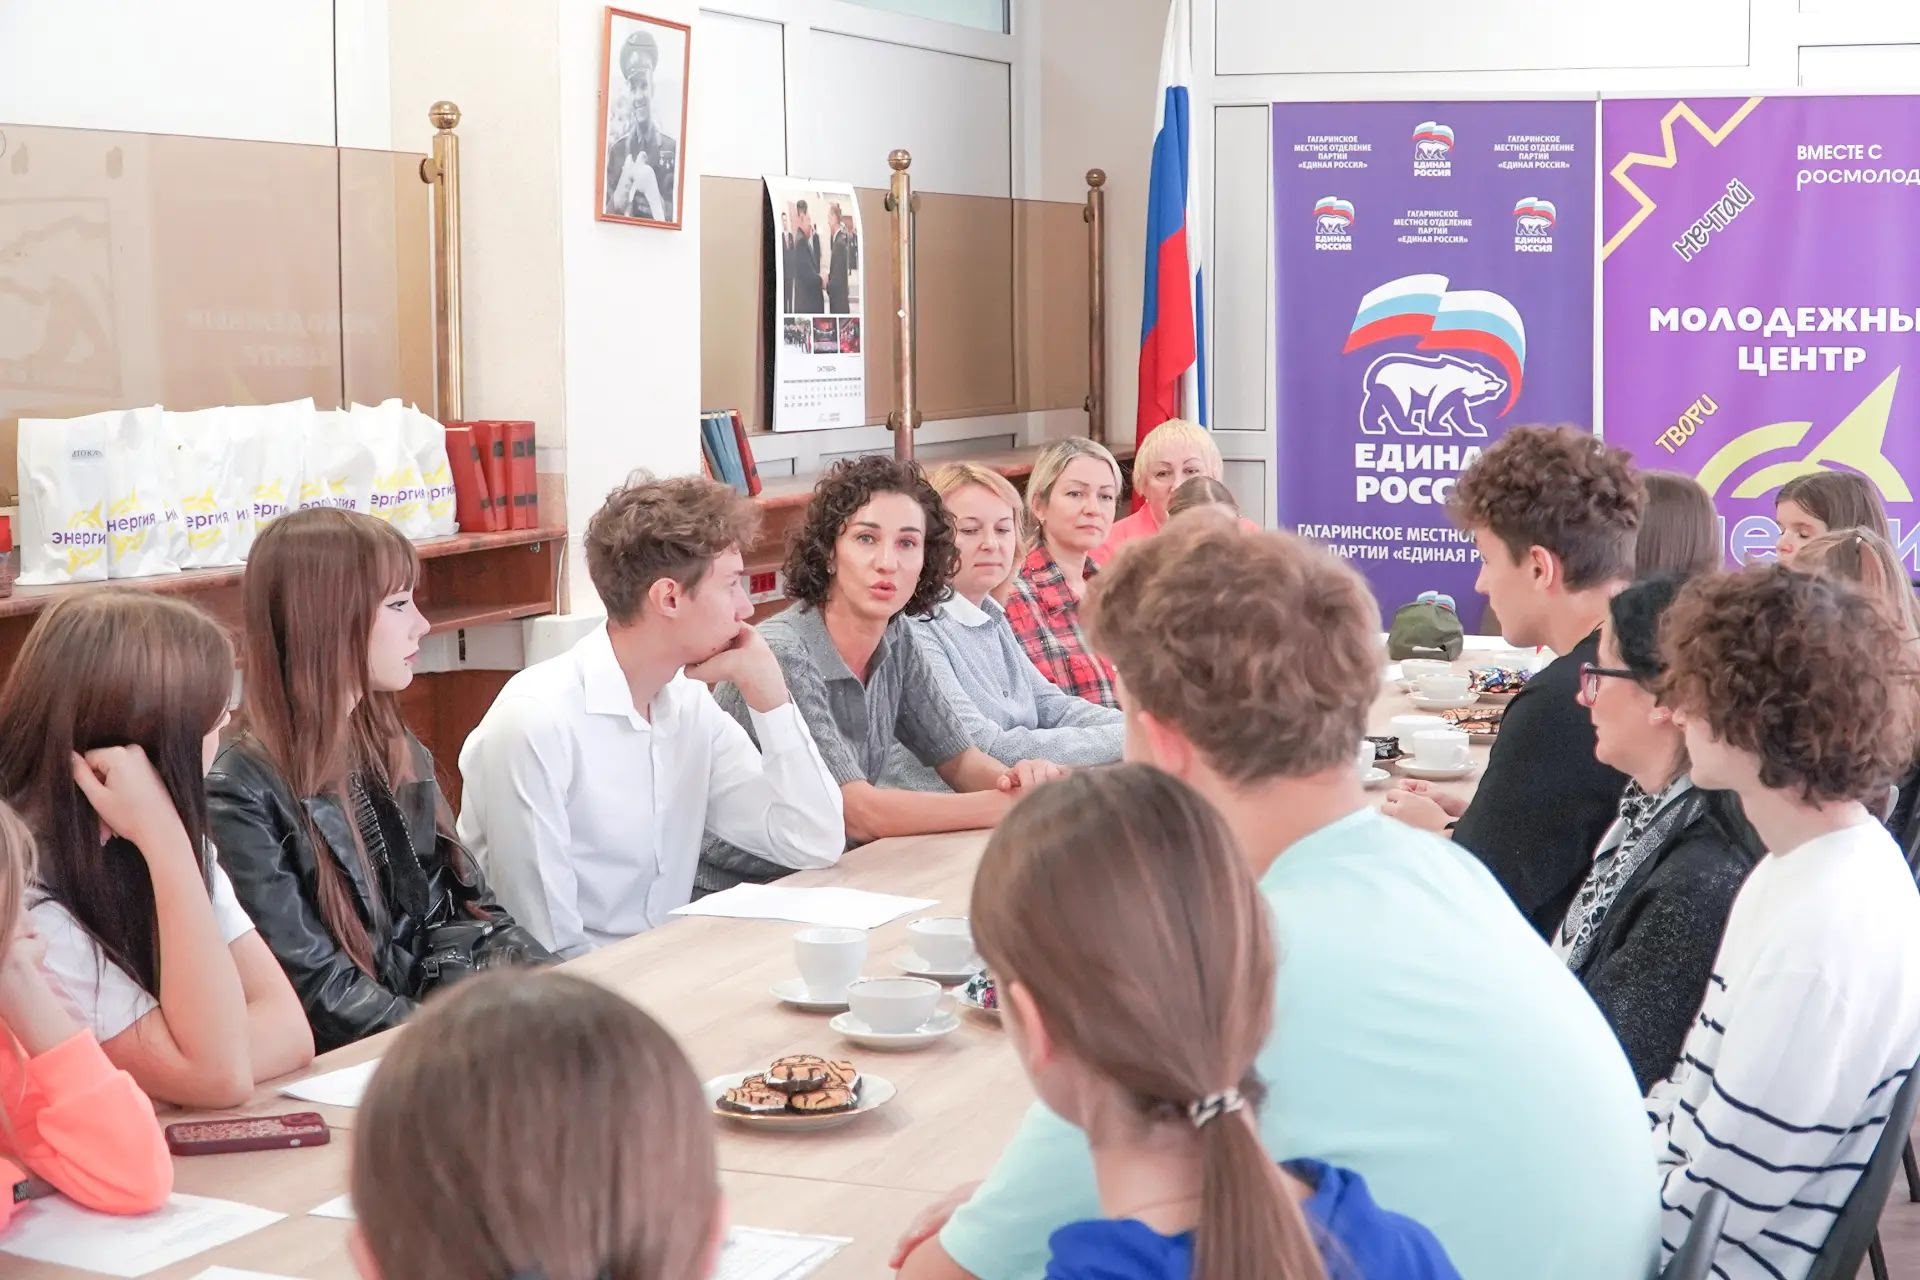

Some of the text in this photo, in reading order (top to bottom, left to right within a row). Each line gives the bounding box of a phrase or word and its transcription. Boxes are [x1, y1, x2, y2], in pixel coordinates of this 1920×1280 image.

[1307, 135, 1358, 143] ГАГАРИНСКОЕ
[1507, 135, 1560, 143] ГАГАРИНСКОЕ
[1293, 144, 1372, 152] МЕСТНОЕ ОТДЕЛЕНИЕ
[1493, 144, 1575, 152] МЕСТНОЕ ОТДЕЛЕНИЕ
[1797, 144, 1882, 160] ВМЕСТЕ С
[1318, 152, 1348, 160] ПАРТИИ
[1518, 152, 1549, 160] ПАРТИИ
[1413, 161, 1451, 169] ЕДИНАЯ
[1413, 169, 1451, 177] РОССИЯ
[1407, 209, 1458, 217] ГАГАРИНСКОЕ
[1393, 218, 1472, 226] МЕСТНОЕ ОТДЕЛЕНИЕ
[1418, 227, 1448, 235] ПАРТИИ
[1315, 235, 1352, 243] ЕДИНАЯ
[1515, 236, 1552, 245] ЕДИНАЯ
[1315, 243, 1352, 251] РОССИЯ
[1515, 244, 1552, 252] РОССИЯ
[1649, 306, 1920, 338] МОЛОДЕЖНЫ
[1738, 346, 1867, 377] ЦЕНТР
[1354, 443, 1484, 473] ЕДИНА
[1356, 476, 1456, 505] РОСС
[107, 512, 156, 532] нергия
[186, 511, 229, 530] ергия
[1297, 523, 1478, 544] ГАГАРИНСКОЕ МЕСТНО
[51, 532, 106, 547] энерги
[1328, 544, 1389, 560] ПАРТИИ
[1393, 547, 1466, 564] «ЕДИНАЯ
